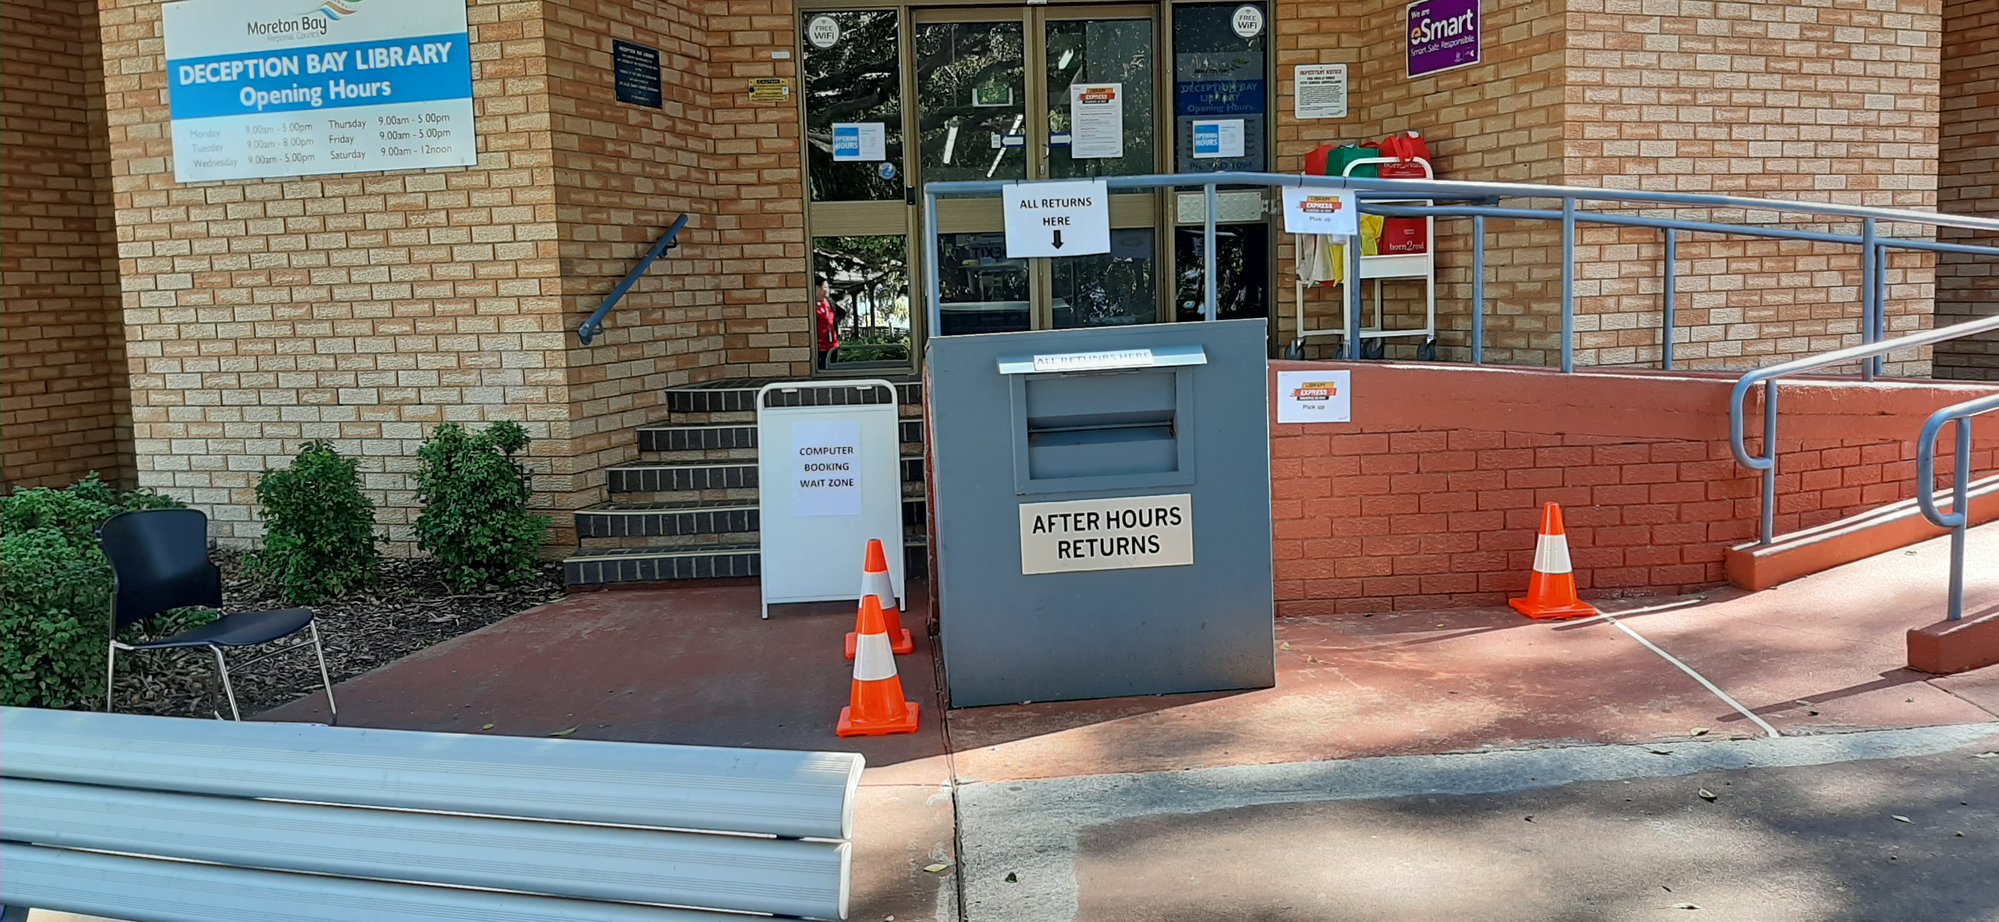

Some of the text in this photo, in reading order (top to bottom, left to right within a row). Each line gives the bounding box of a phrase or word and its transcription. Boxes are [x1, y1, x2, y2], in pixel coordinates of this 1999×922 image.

[1411, 8, 1430, 19] We are
[247, 16, 328, 36] Moreton Bay
[1237, 21, 1258, 29] WiFi
[1410, 8, 1474, 46] eSmart
[266, 30, 320, 43] Regional Council
[178, 41, 453, 86] DECEPTION BAY LIBRARY
[239, 79, 392, 110] Opening Hours
[328, 119, 367, 130] Thursday
[378, 115, 409, 127] 9.00am
[417, 112, 450, 124] 5.00pm
[189, 129, 221, 140] Monday
[245, 124, 275, 135] 9.00am
[282, 122, 313, 133] 5.00pm
[328, 134, 355, 145] Friday
[379, 130, 410, 141] 9.00am
[418, 128, 451, 140] 5.00pm
[191, 143, 224, 154] Tuesday
[246, 139, 276, 149] 9.00am
[283, 137, 314, 147] 8.00pm
[1195, 138, 1218, 146] HOURS
[330, 149, 366, 160] Saturday
[380, 146, 412, 157] 9.00am
[421, 144, 452, 154] 12noon
[192, 157, 238, 169] Wednesday
[248, 154, 277, 165] 9.00am
[284, 152, 315, 163] 5.00pm
[1019, 197, 1092, 209] ALL RETURNS
[1042, 216, 1071, 227] HERE
[1036, 357, 1055, 365] ALL
[1118, 351, 1151, 361] HERE
[799, 446, 854, 456] COMPUTER
[804, 462, 850, 472] BOOKING
[799, 478, 854, 488] WAIT ZONE
[1032, 506, 1182, 535] AFTER HOURS
[1057, 534, 1160, 560] RETURNS
